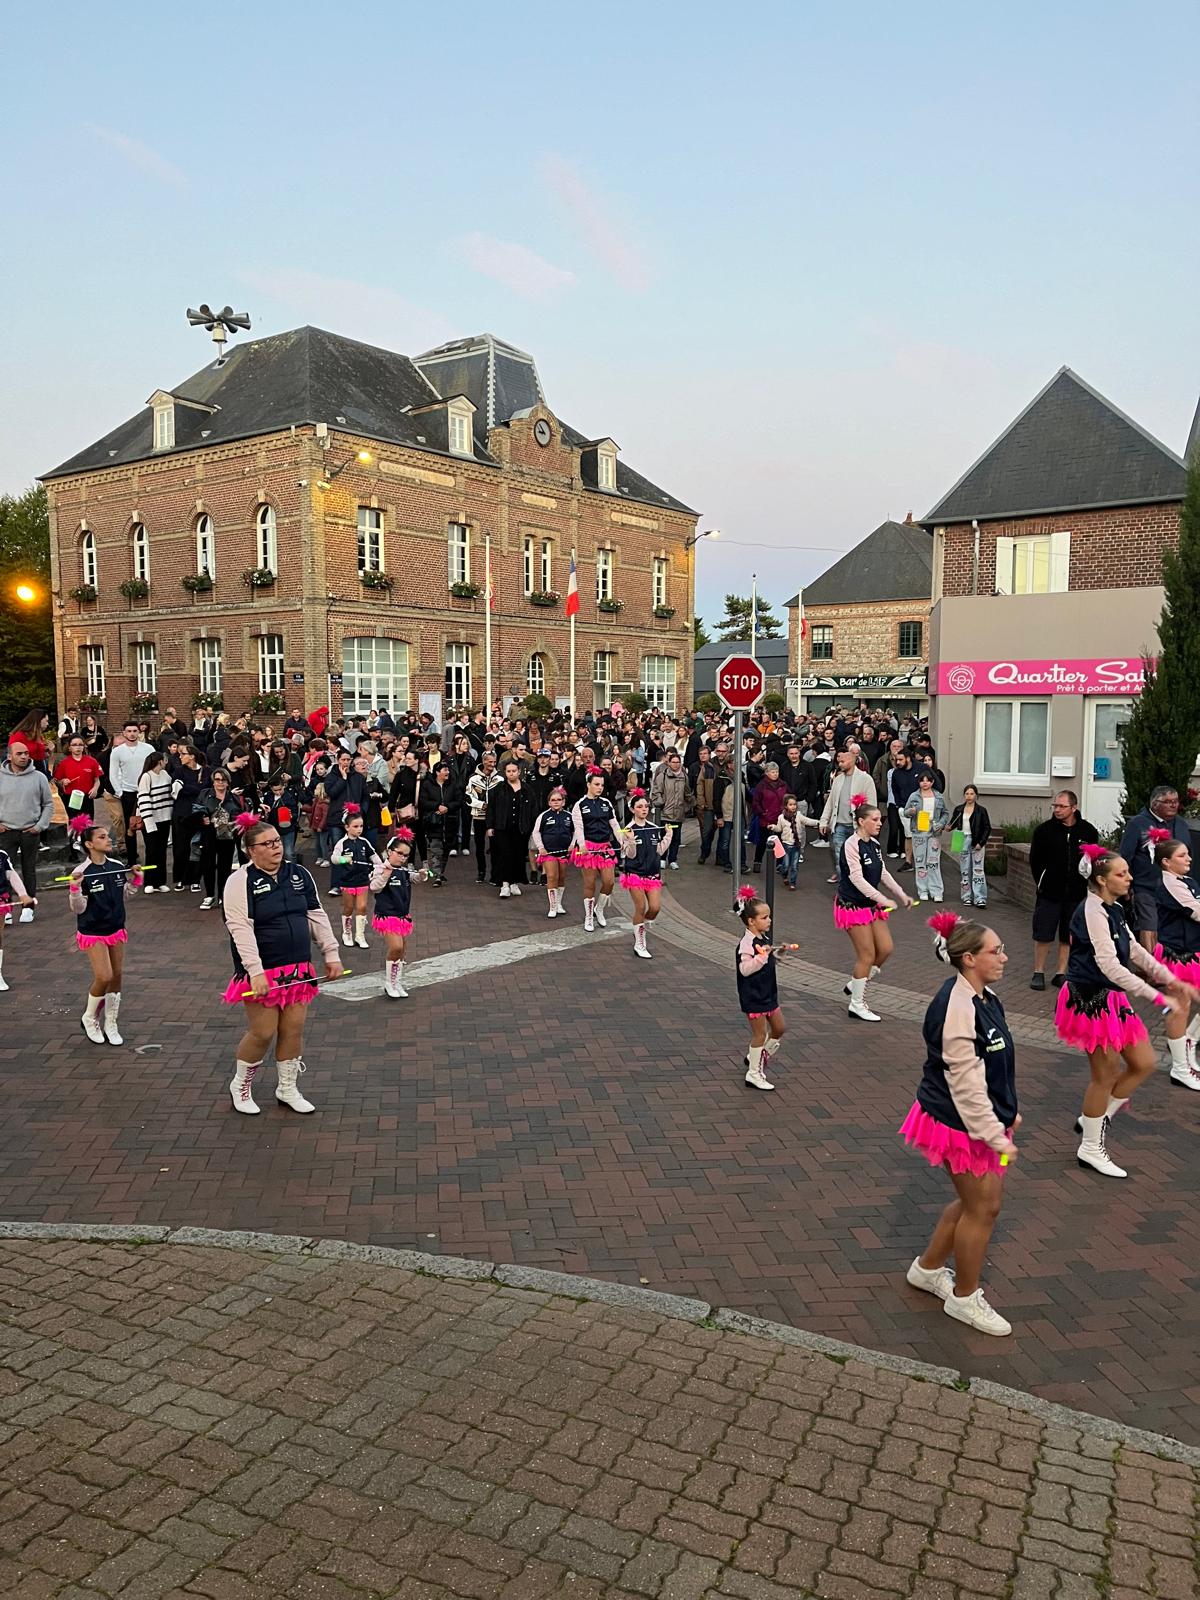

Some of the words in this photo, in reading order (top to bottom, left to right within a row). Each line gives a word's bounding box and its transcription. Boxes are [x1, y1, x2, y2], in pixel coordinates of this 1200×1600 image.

[988, 662, 1089, 684] Quartier
[722, 674, 759, 690] STOP
[839, 677, 857, 686] Bar
[858, 678, 868, 686] de
[1056, 684, 1075, 692] Prêt
[1078, 683, 1085, 692] à
[1087, 684, 1117, 693] porter
[1120, 684, 1131, 692] et
